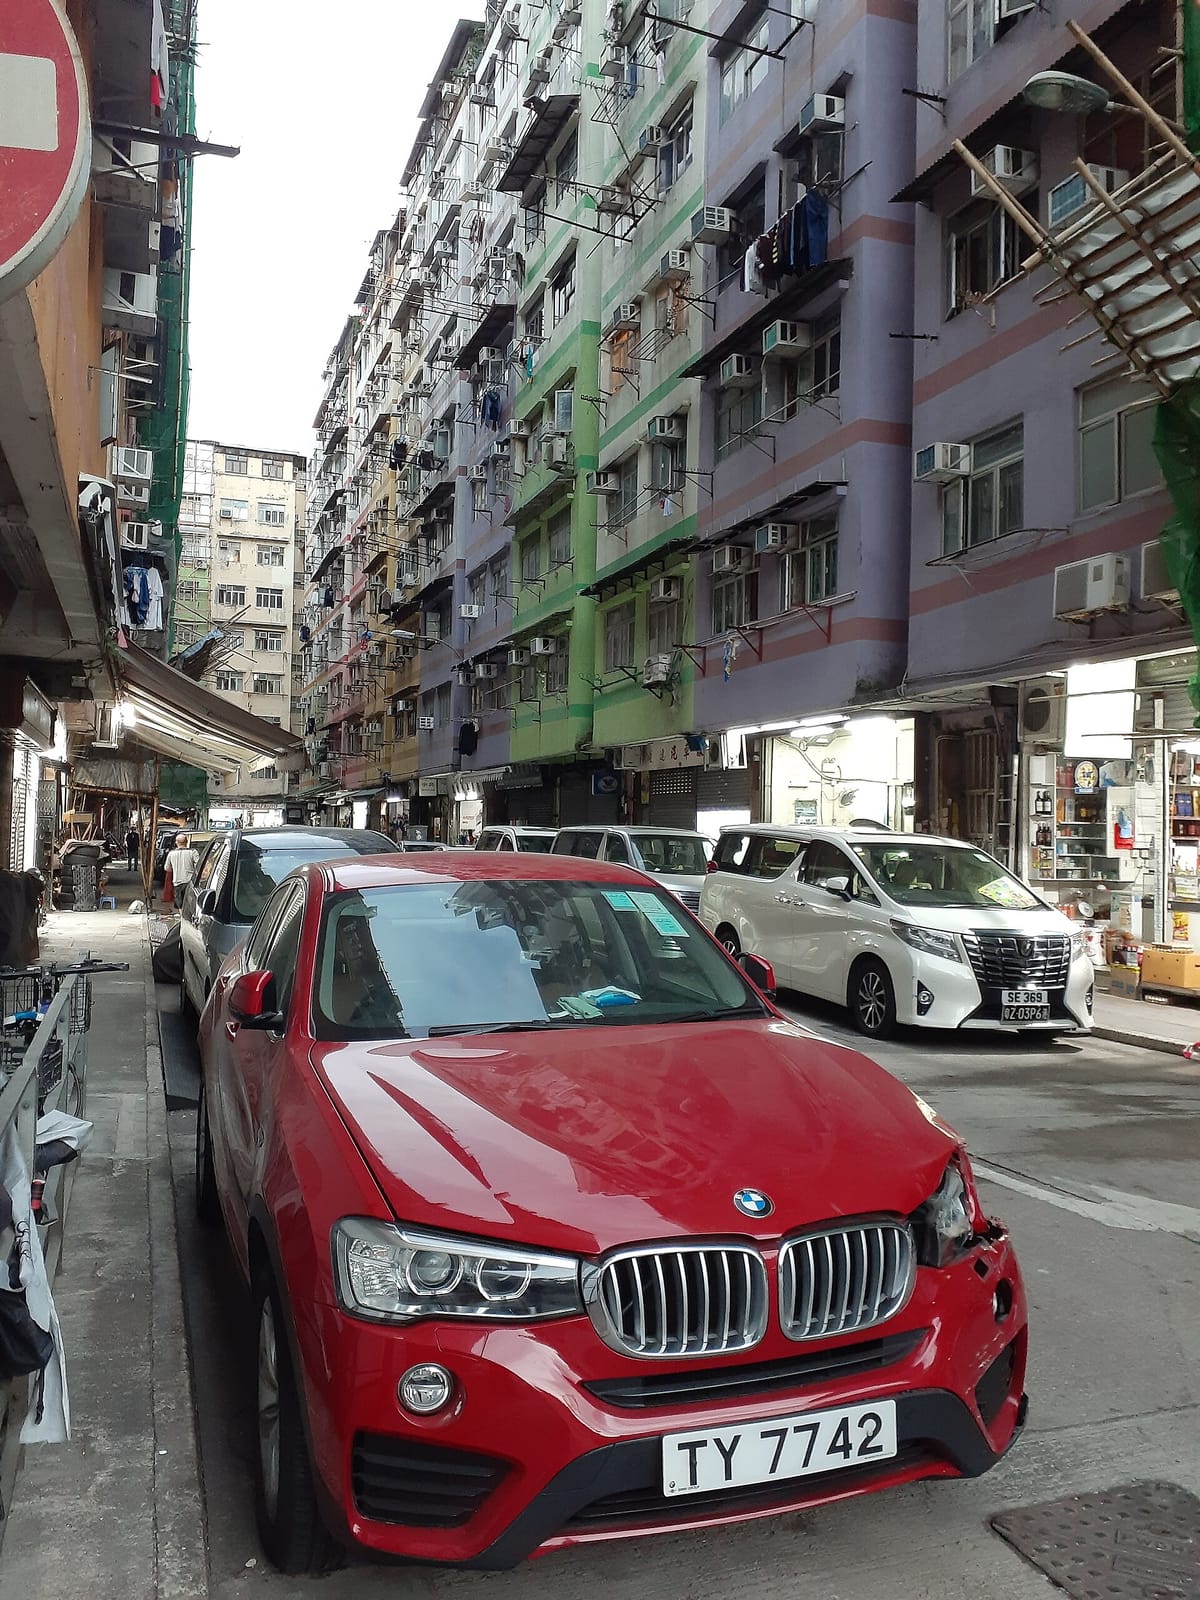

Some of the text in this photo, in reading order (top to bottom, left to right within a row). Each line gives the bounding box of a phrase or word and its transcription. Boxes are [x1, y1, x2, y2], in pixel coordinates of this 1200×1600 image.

[1008, 992, 1042, 1002] SE 369
[678, 1412, 883, 1486] TY 7742
